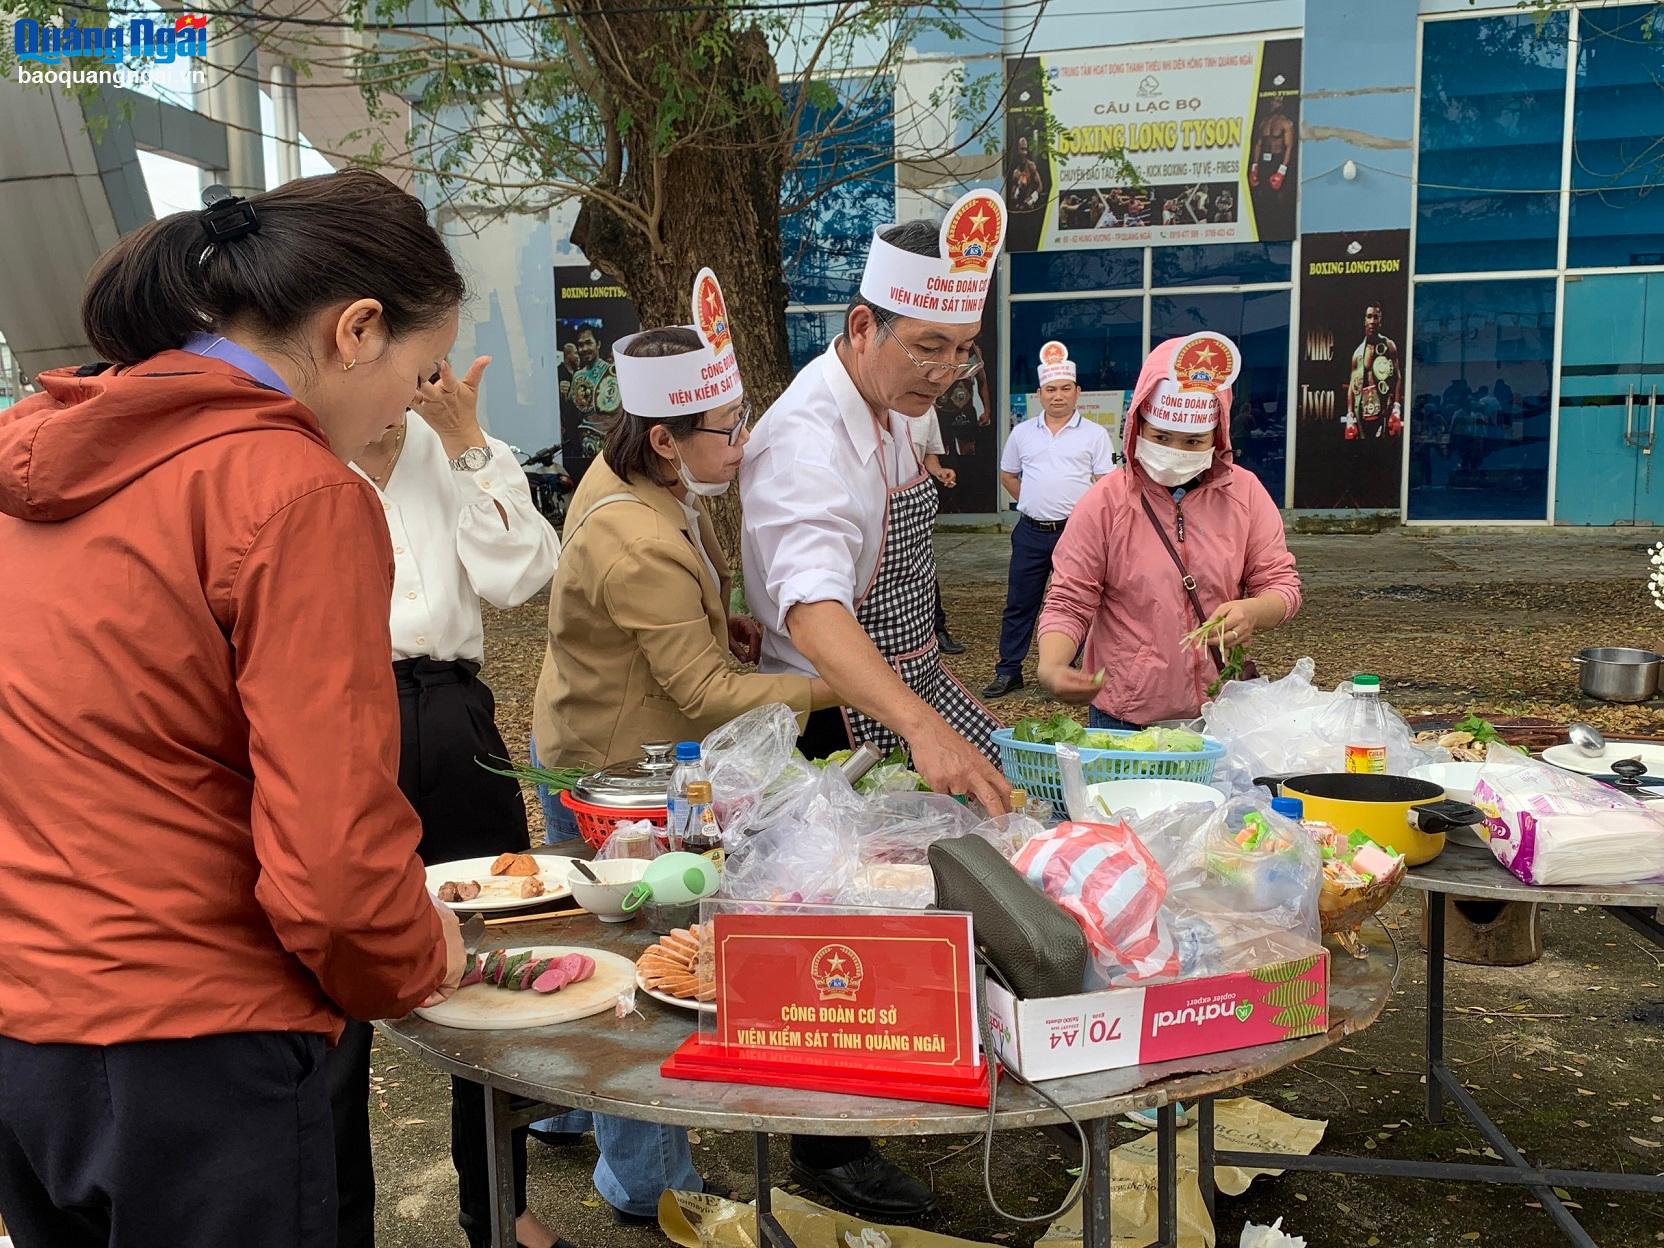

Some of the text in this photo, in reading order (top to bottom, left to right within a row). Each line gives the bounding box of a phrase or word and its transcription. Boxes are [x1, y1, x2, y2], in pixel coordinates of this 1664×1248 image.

[1093, 97, 1202, 115] CÂU LẠC BỘ
[1128, 120, 1178, 153] LONG
[1180, 116, 1243, 149] TYSON
[1309, 259, 1400, 275] BOXING LONGTYSON
[561, 287, 589, 299] BOXING
[927, 276, 954, 293] CÔNG
[956, 278, 977, 293] ĐOÀN
[890, 286, 912, 305] VIỆN
[912, 290, 939, 311] KIỂM
[941, 296, 960, 312] SÁT
[961, 295, 978, 312] TỈNH
[701, 361, 724, 380] CÔNG
[669, 388, 693, 407] VIỆN
[695, 381, 720, 402] KIỂM
[721, 375, 734, 393] SÁT
[1161, 394, 1183, 409] CÔNG
[1184, 397, 1208, 410] ĐOÀN
[1152, 405, 1170, 421] KIỂM
[1171, 410, 1188, 424] SÁT
[1190, 411, 1208, 424] TỈNH
[1186, 992, 1237, 1007] copier expert
[781, 1003, 898, 1025] CÔNG ĐOÀN CƠ SỞ
[1151, 1001, 1236, 1038] natural
[737, 1023, 945, 1053] VIỆN KIỂM SÁT TỈNH QUẢNG NGÃI
[1049, 1029, 1080, 1050] A4
[1089, 1017, 1122, 1043] 70
